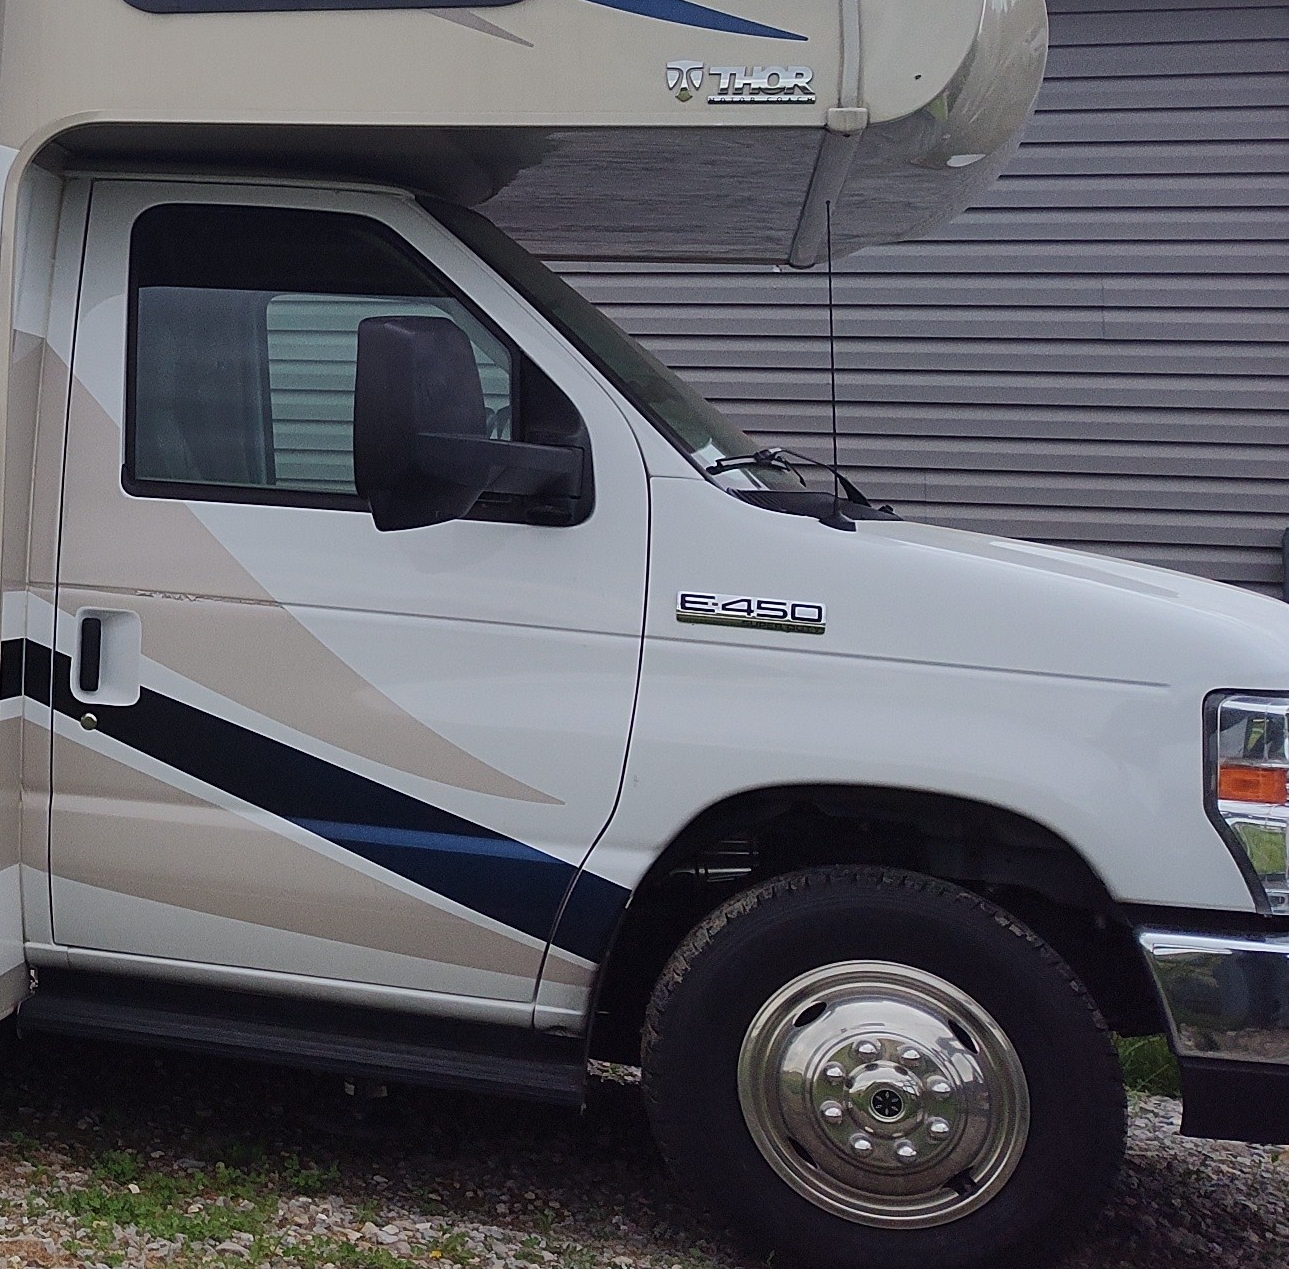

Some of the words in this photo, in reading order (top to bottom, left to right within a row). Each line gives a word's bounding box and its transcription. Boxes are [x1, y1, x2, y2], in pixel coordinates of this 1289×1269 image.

[709, 66, 815, 95] THOR
[708, 96, 755, 104] MOTOR
[767, 96, 814, 104] COACH
